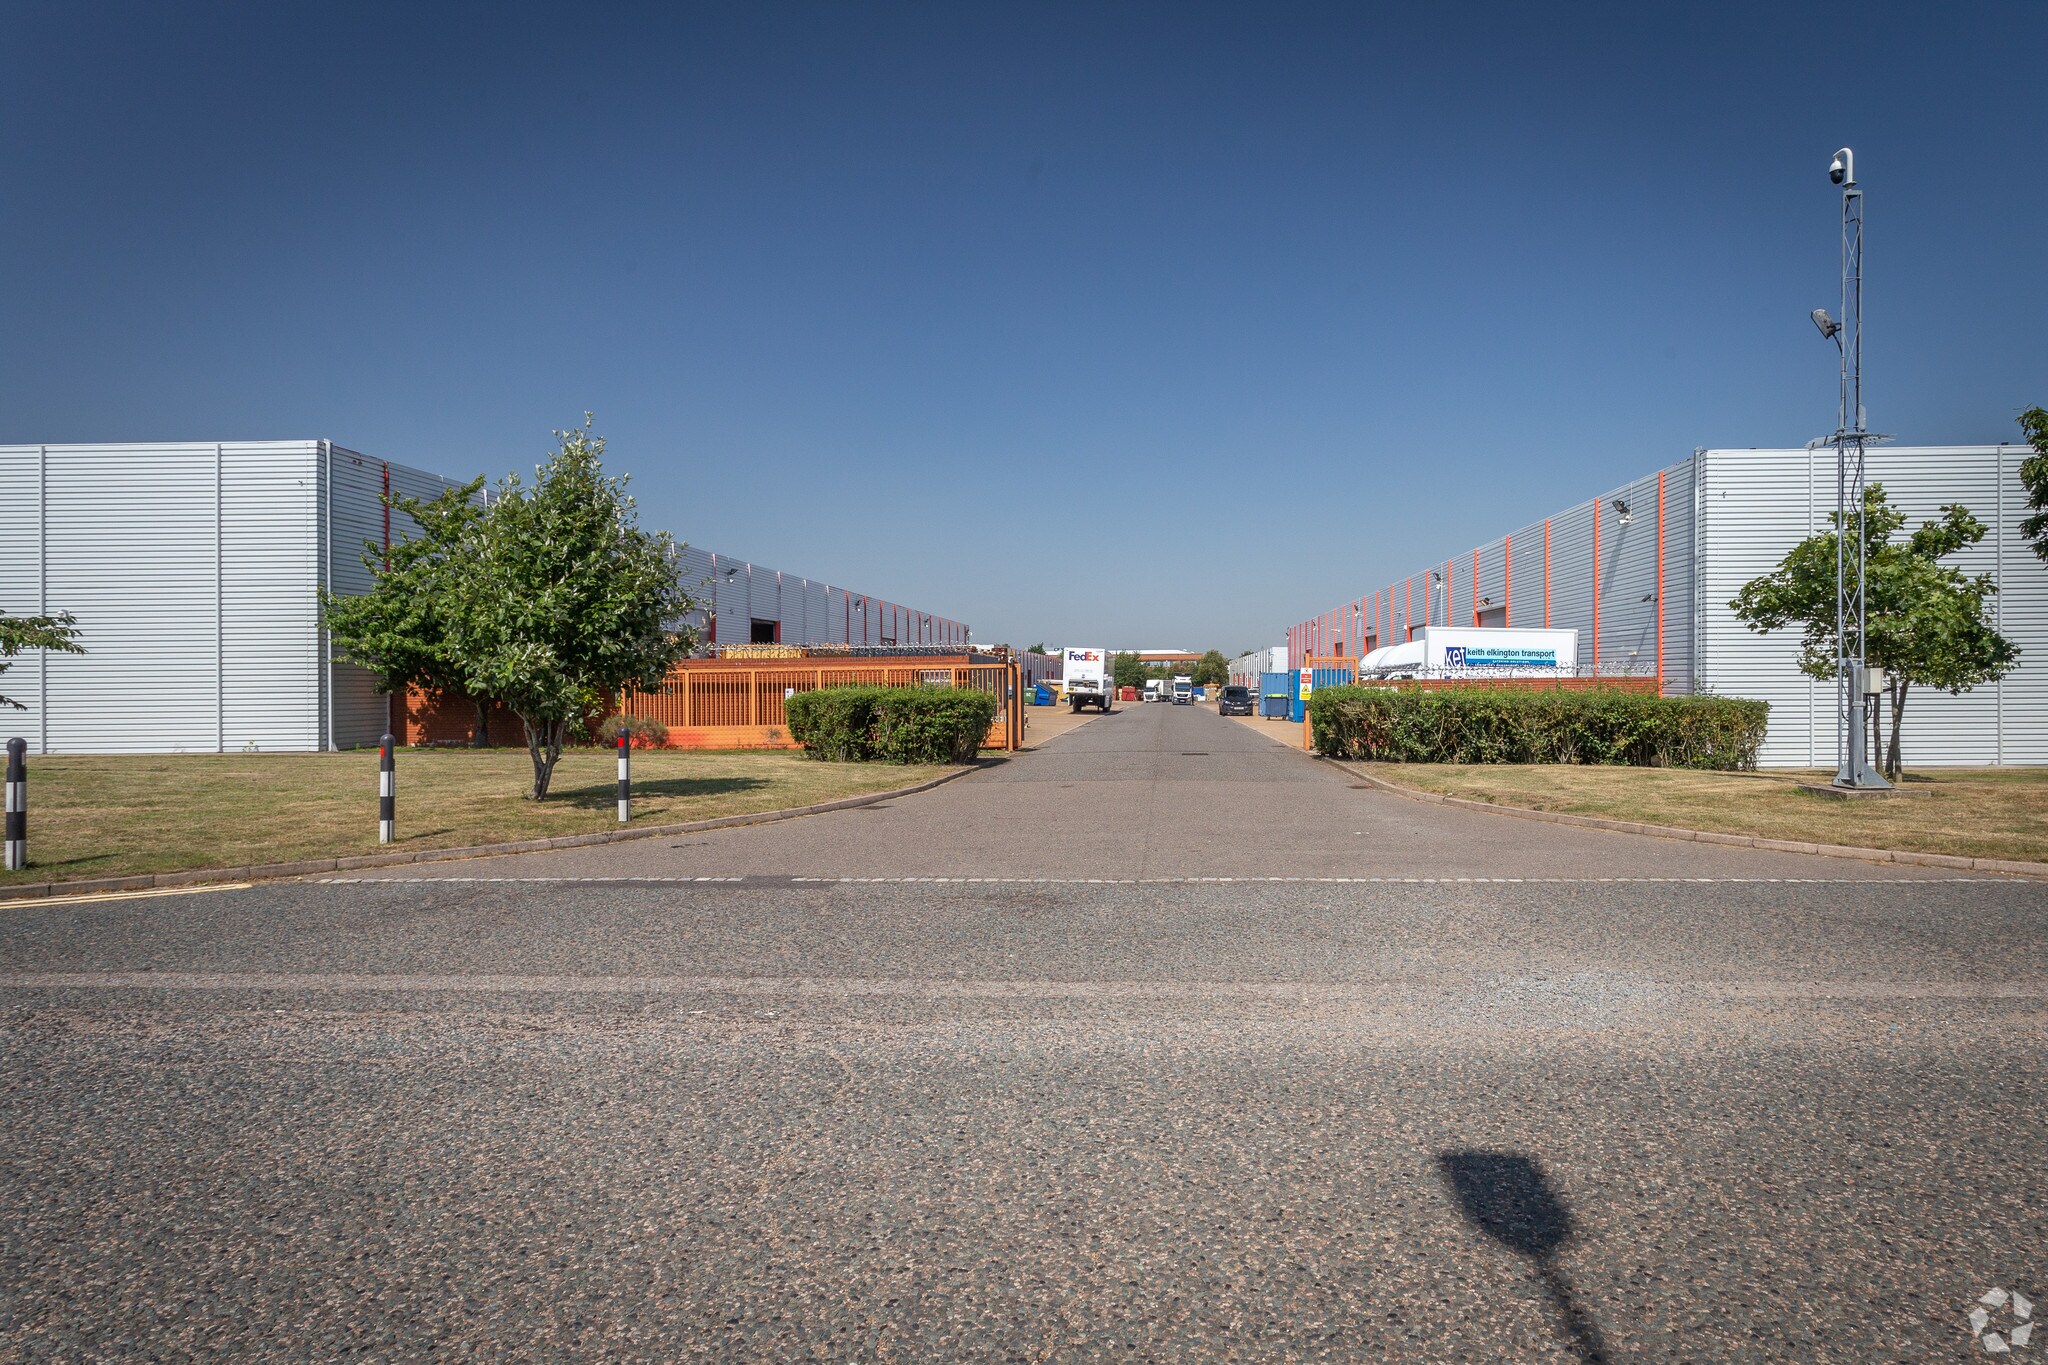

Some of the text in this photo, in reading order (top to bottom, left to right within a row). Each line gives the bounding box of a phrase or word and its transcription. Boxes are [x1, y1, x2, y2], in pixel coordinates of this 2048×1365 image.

[1069, 651, 1099, 661] FedEx
[1445, 647, 1466, 667] ket
[1467, 648, 1555, 659] keith elkington transport
